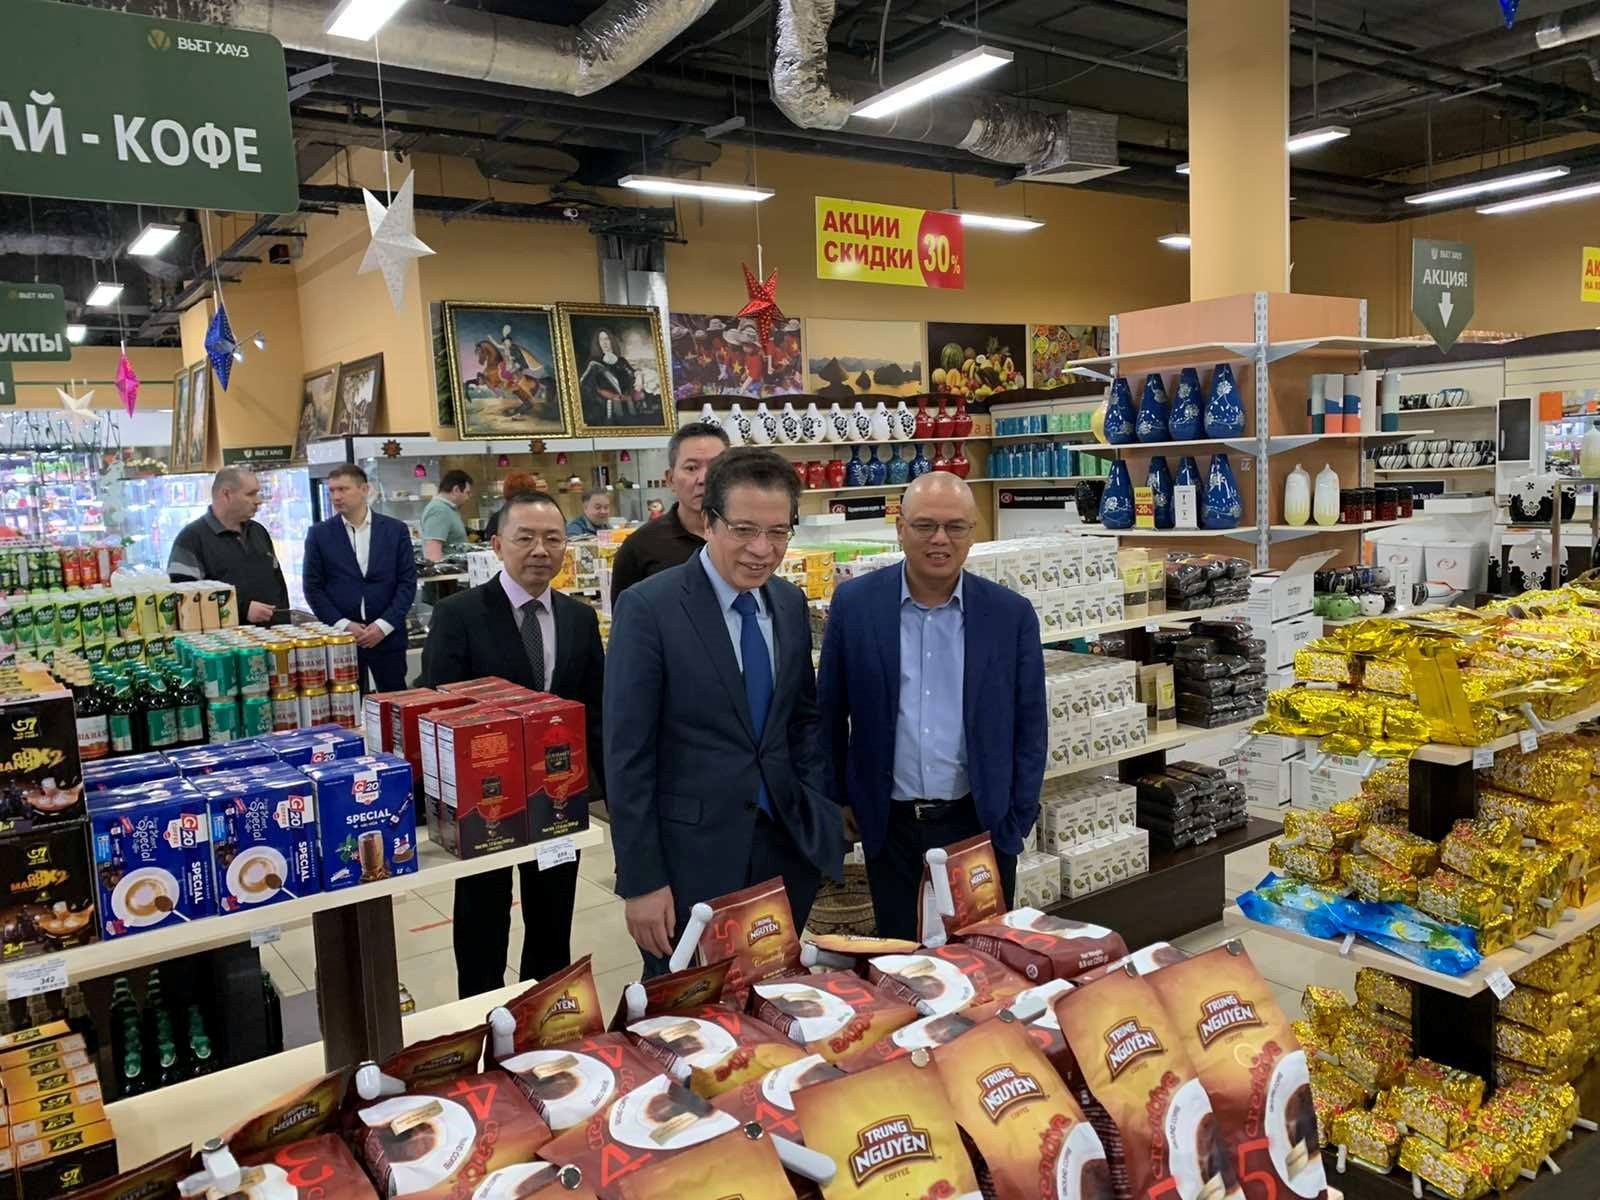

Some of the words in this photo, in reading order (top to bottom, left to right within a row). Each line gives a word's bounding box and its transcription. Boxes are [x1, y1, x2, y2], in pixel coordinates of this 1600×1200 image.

[177, 37, 212, 53] ВЬЕТ
[215, 42, 249, 58] ХАУЗ
[113, 114, 262, 173] КОФЕ
[823, 211, 900, 239] АКЦИИ
[824, 240, 913, 271] СКИДКИ
[1422, 269, 1468, 288] АКЦИЯ!
[354, 780, 380, 794] G20
[288, 797, 304, 827] G20
[346, 808, 392, 825] SPECIAL
[181, 815, 199, 847] G20
[298, 841, 310, 882] SPECIAL
[191, 861, 204, 905] SPECIAL
[1205, 994, 1239, 1014] TRUNG
[1108, 1021, 1138, 1044] TRUNG
[981, 1066, 1016, 1089] TRUNG
[448, 1079, 498, 1120] 4
[865, 1119, 908, 1144] TRUNG
[1237, 1136, 1278, 1200] 5
